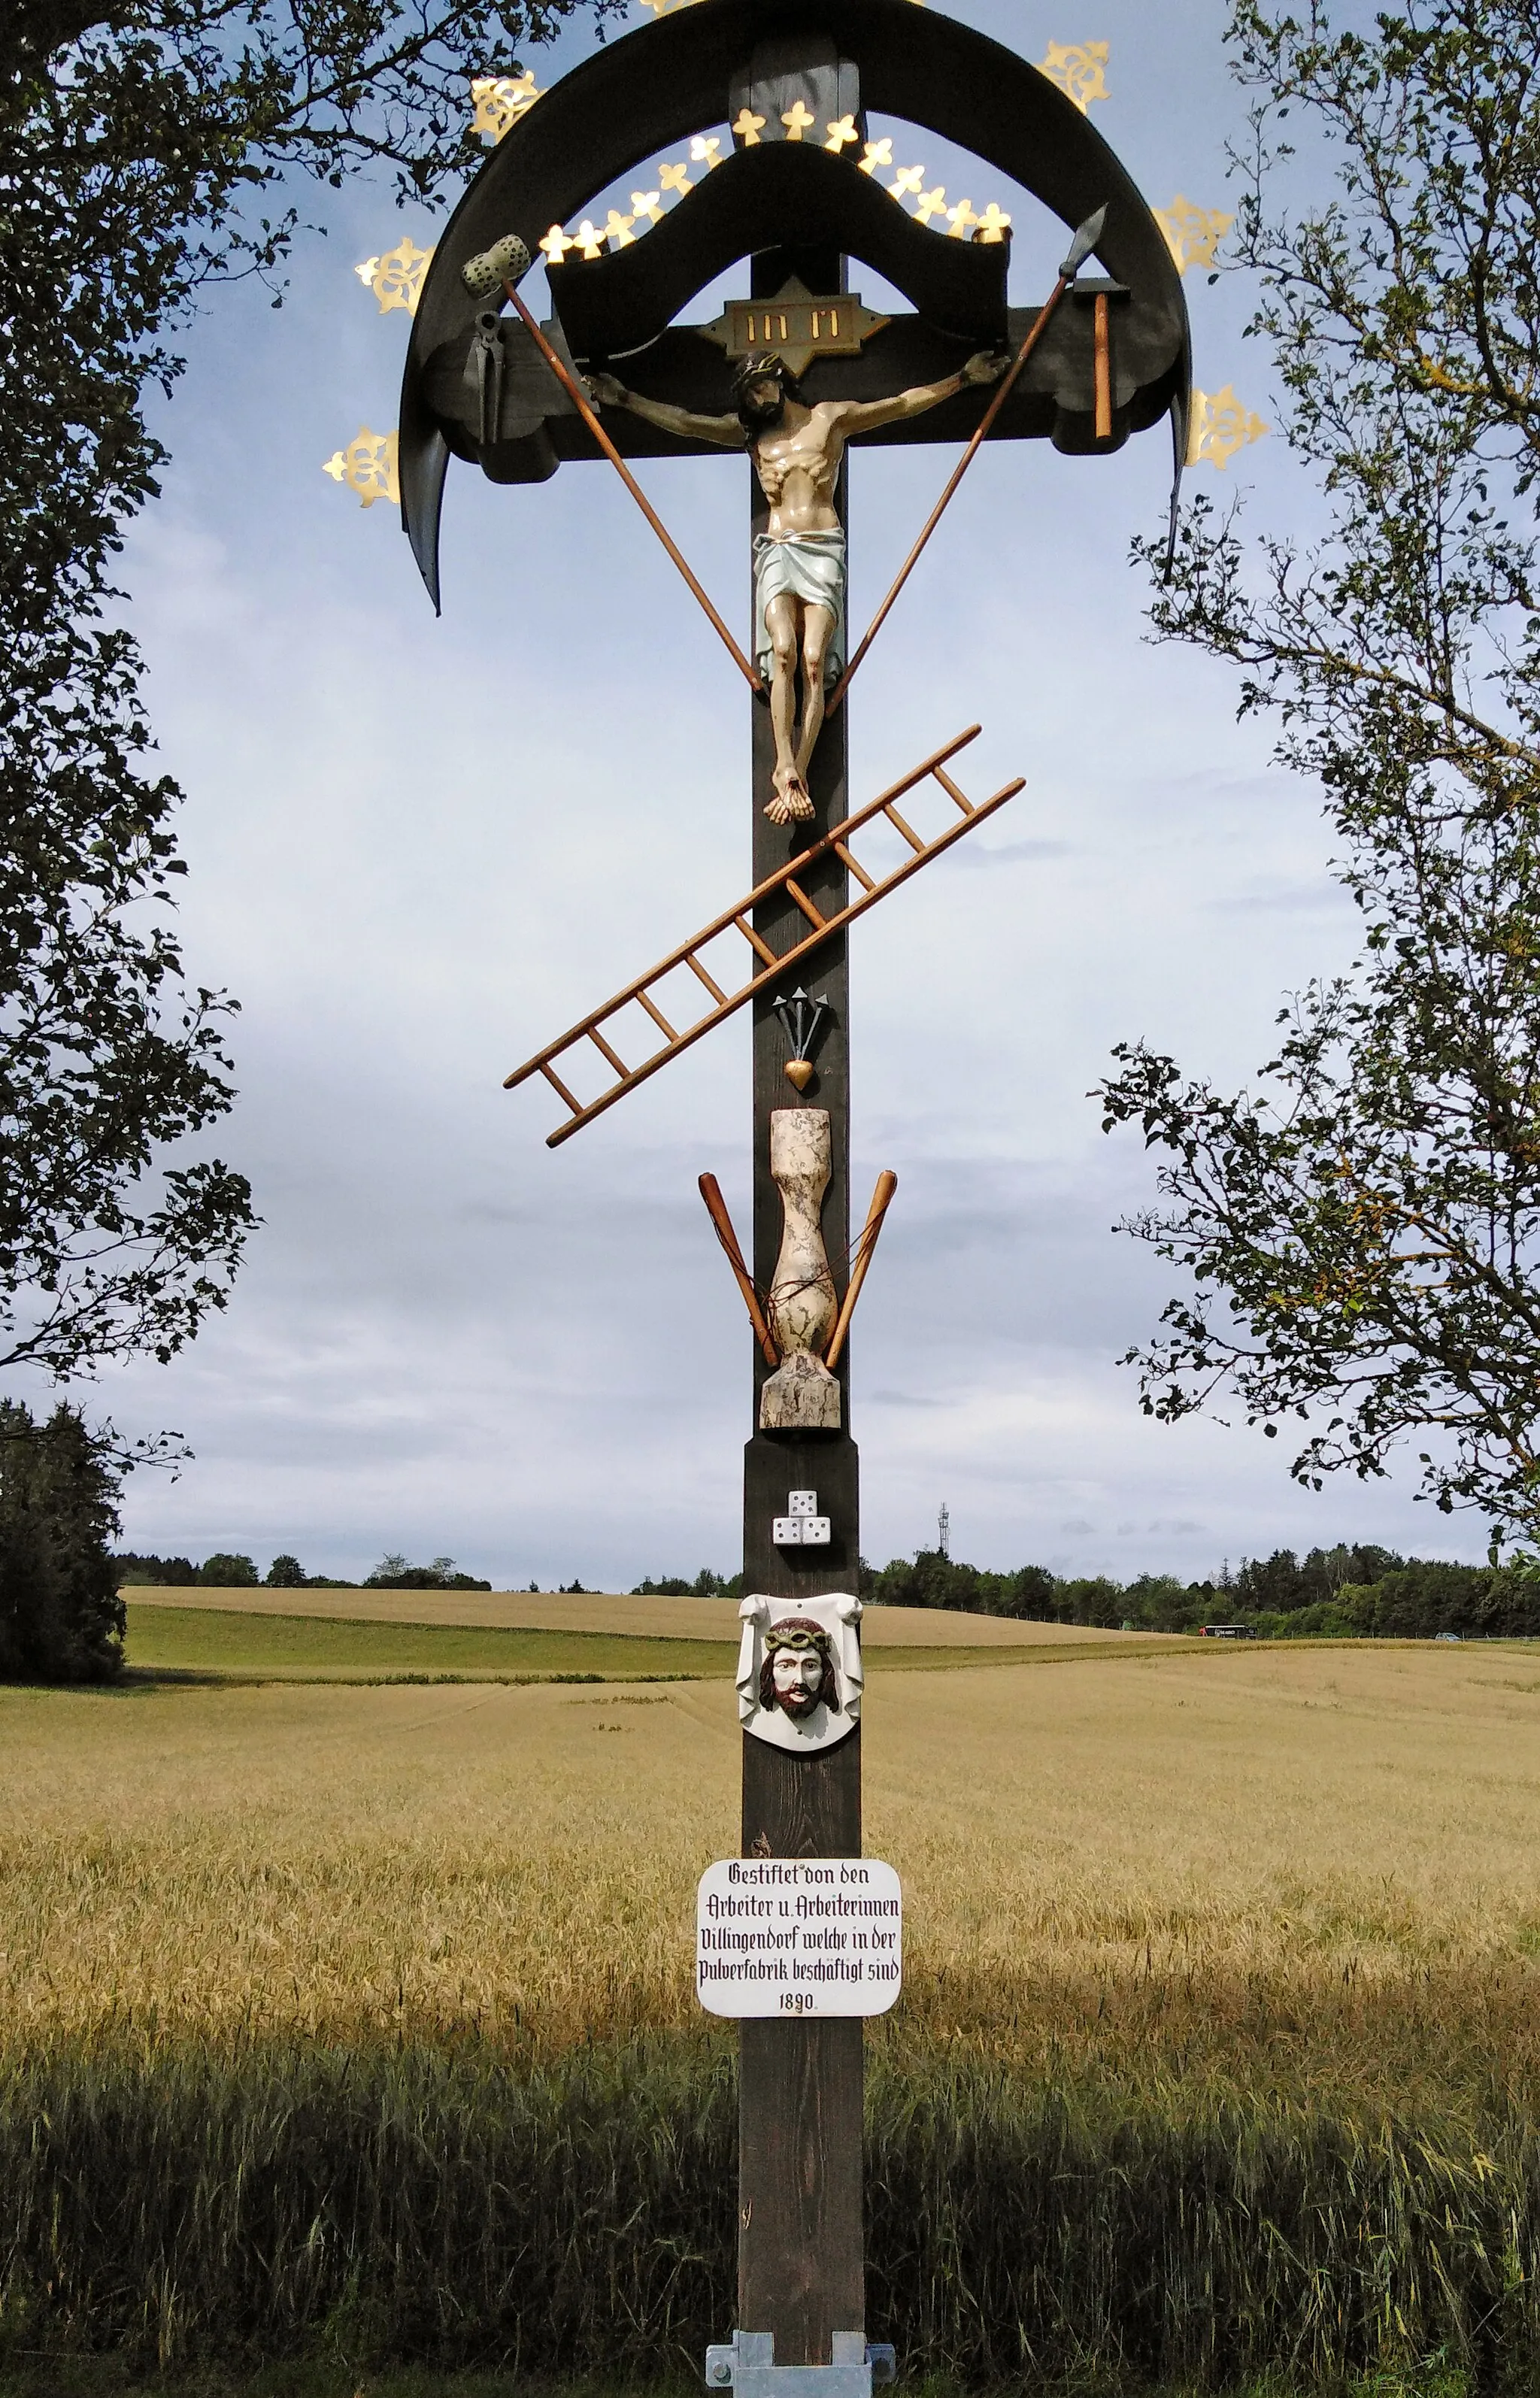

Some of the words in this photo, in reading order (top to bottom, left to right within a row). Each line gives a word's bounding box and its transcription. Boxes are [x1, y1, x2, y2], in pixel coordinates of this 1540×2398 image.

[728, 1862, 799, 1884] Gestiftet
[805, 1865, 835, 1884] von
[840, 1862, 869, 1884] den
[705, 1893, 773, 1921] Arbeiter
[778, 1899, 794, 1917] u.
[795, 1893, 899, 1921] Arbeiterinnen
[700, 1924, 800, 1954] Villingendorf
[802, 1926, 847, 1951] welche
[852, 1926, 869, 1950] in
[872, 1923, 896, 1950] der
[793, 1957, 864, 1984] beschäftigt
[867, 1955, 899, 1981] sind
